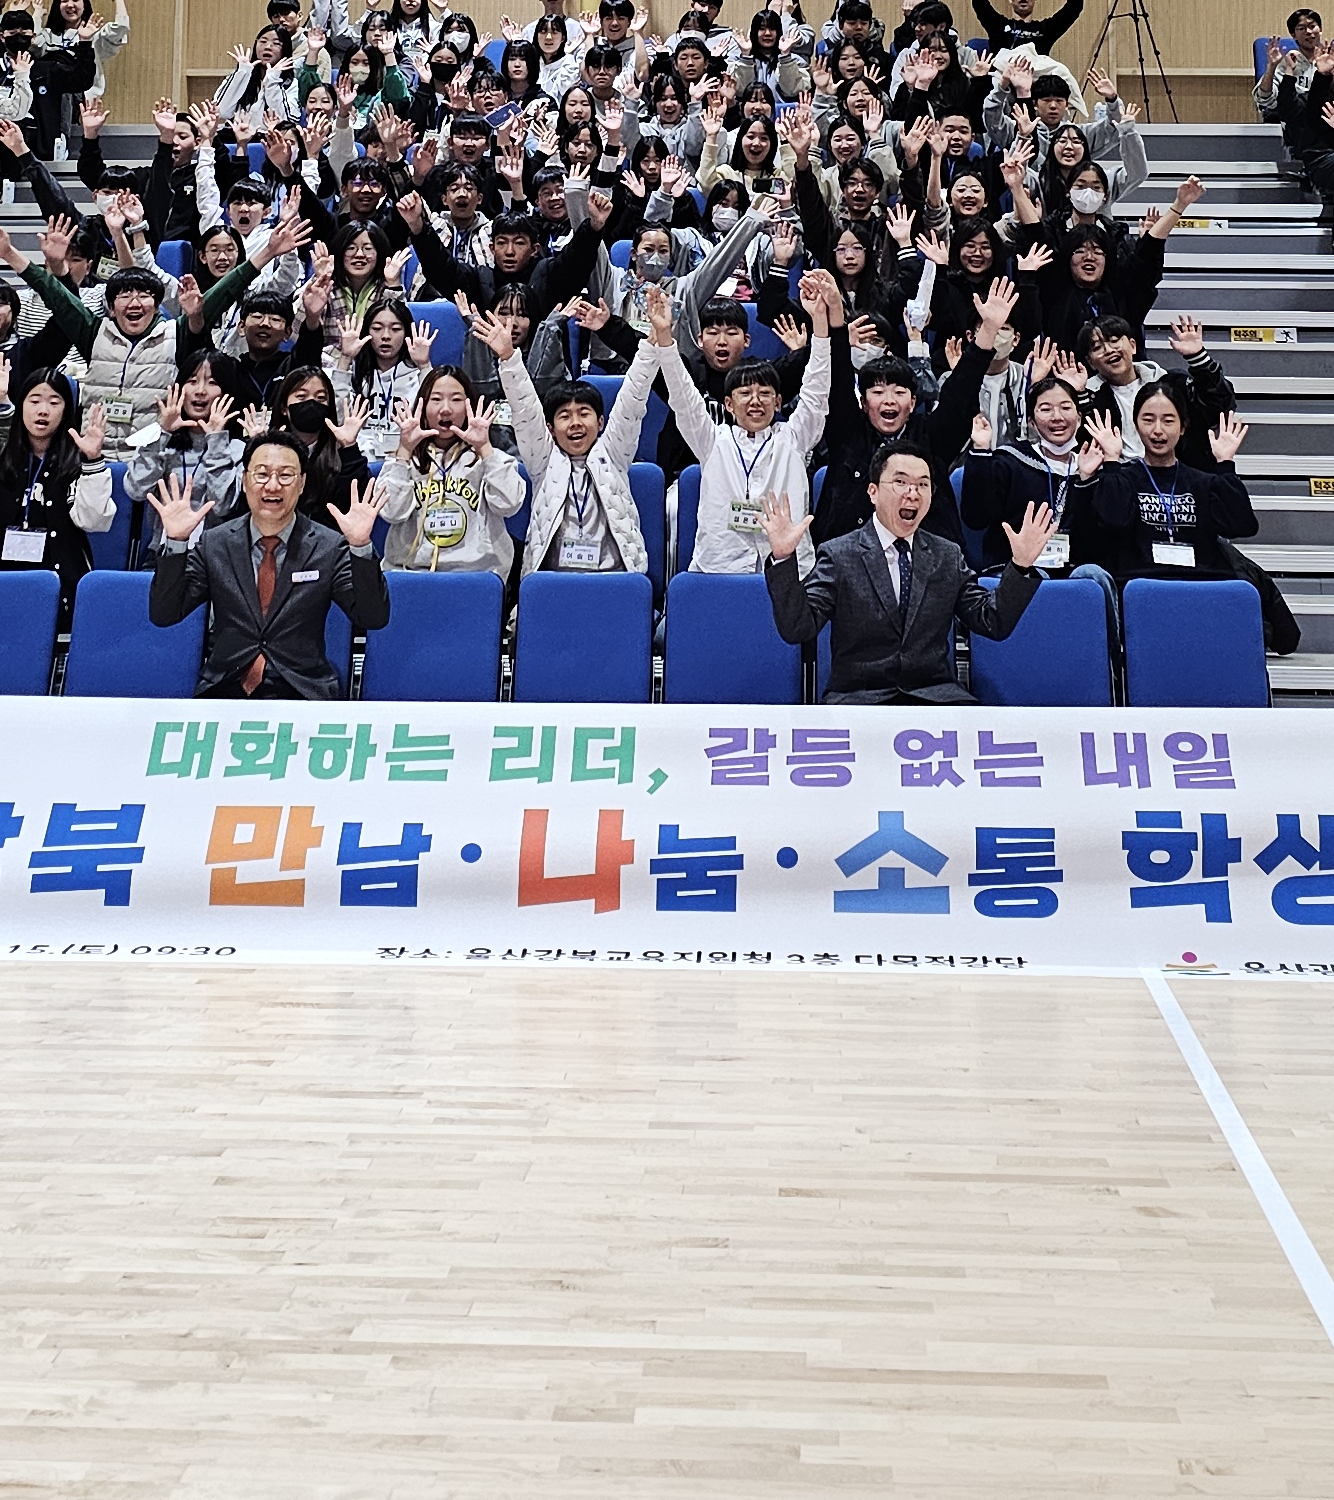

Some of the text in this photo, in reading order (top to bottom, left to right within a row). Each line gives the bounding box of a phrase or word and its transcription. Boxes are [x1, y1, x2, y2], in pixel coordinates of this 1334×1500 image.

[147, 722, 1235, 793] 대화하는 리더, 갈등 없는 내일
